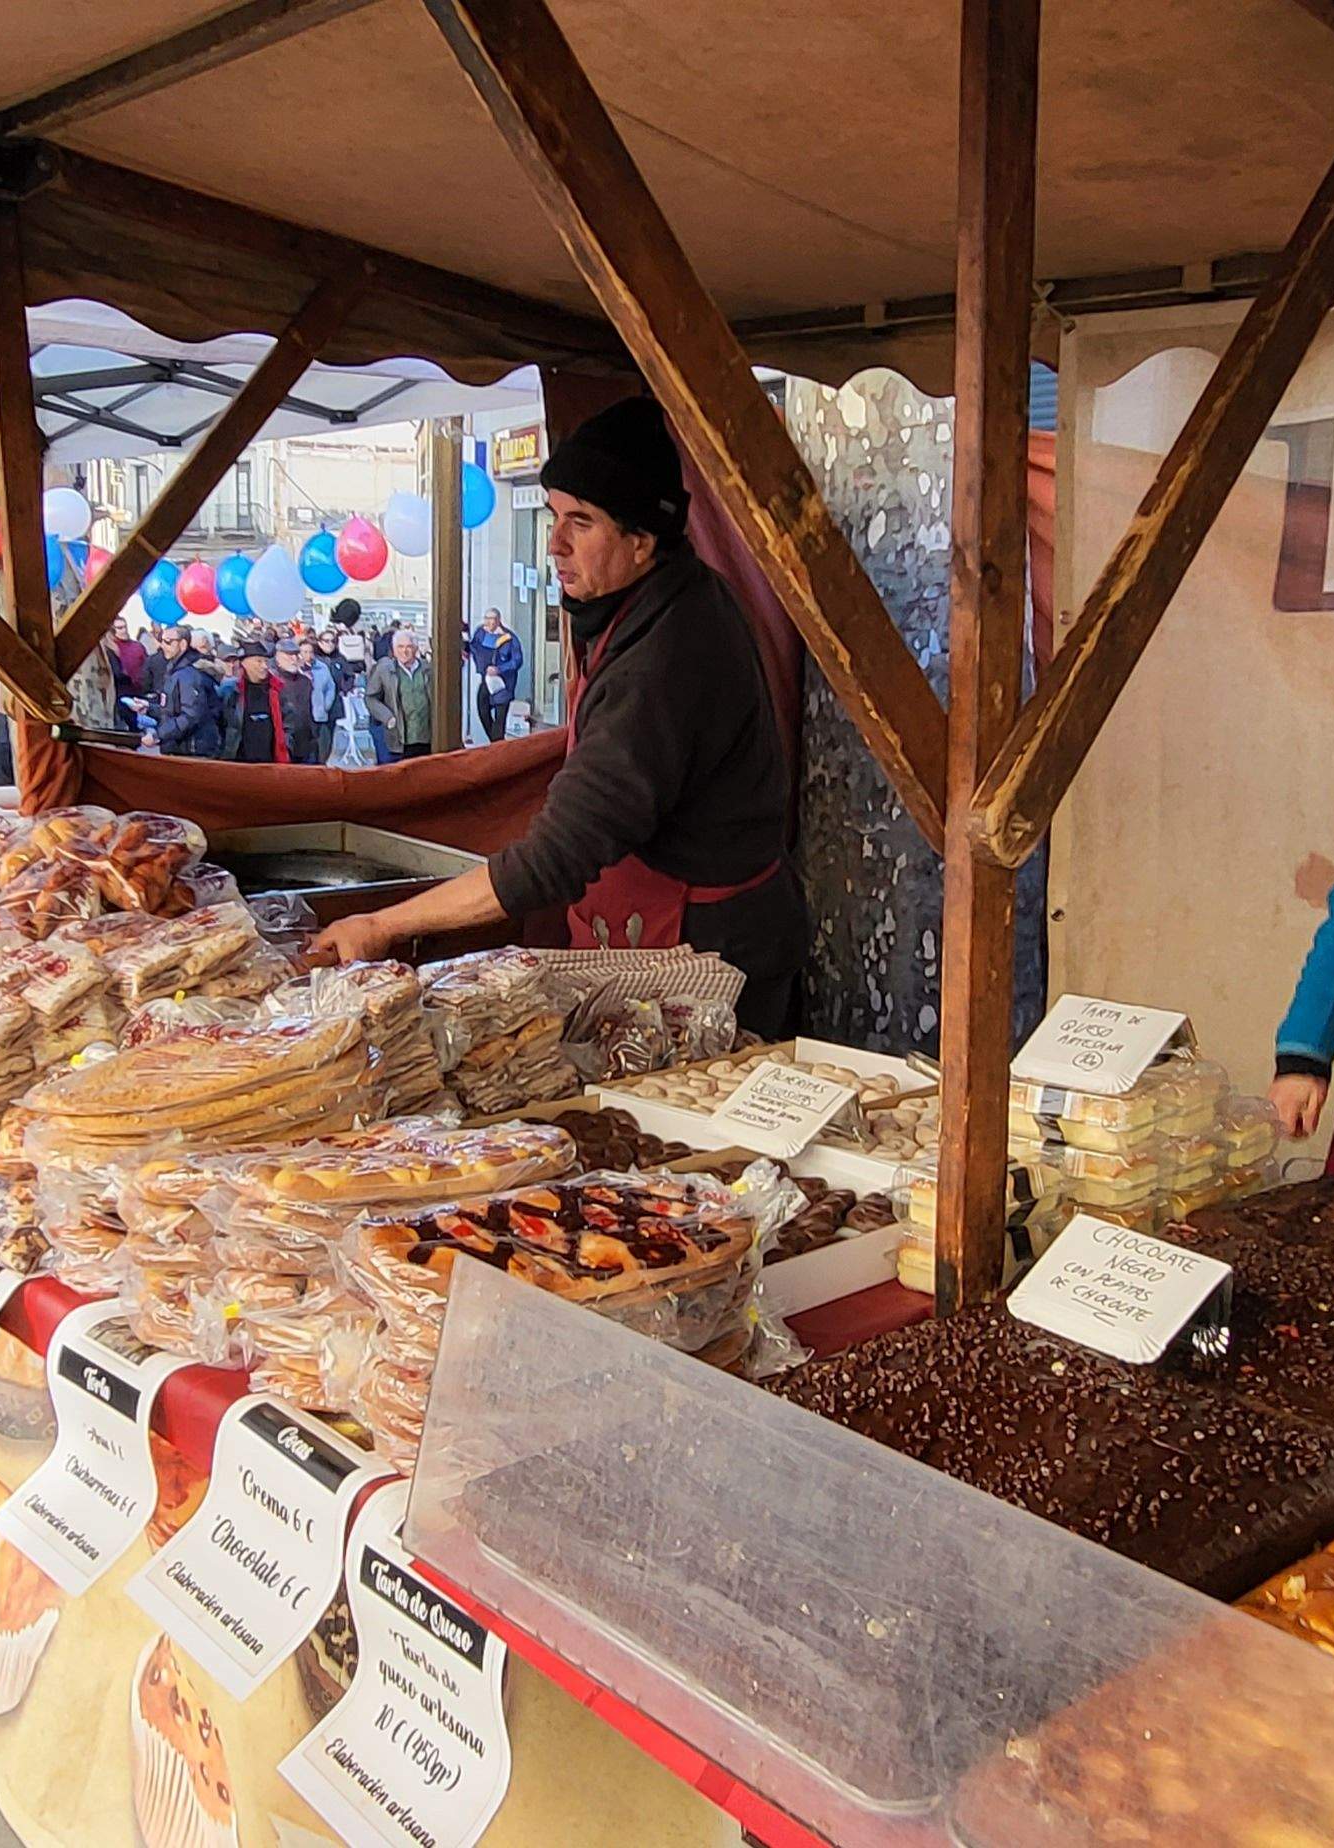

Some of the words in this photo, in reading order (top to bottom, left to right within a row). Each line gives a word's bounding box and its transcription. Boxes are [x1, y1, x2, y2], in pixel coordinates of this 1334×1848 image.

[1061, 1020, 1113, 1037] QUESO
[1080, 1001, 1122, 1023] TARTA
[1127, 1016, 1146, 1025] DE
[1058, 1035, 1124, 1053] ARTESANA
[1064, 1262, 1093, 1278] CON
[1092, 1226, 1201, 1273] CHOCOLATE
[1105, 1255, 1166, 1282] NEGRO
[1050, 1275, 1069, 1289] DE
[1072, 1284, 1154, 1322] CHOCOLATE
[277, 1426, 314, 1461] Cocas
[242, 1468, 289, 1525] Crema
[211, 1518, 280, 1588] Chocolate
[166, 1561, 223, 1618] Elaboración
[219, 1611, 265, 1656] artesana
[371, 1560, 411, 1610] Tarta
[410, 1591, 428, 1621] de
[429, 1604, 474, 1653] Queso
[394, 1632, 439, 1682] Tarta
[441, 1669, 461, 1697] de
[375, 1703, 394, 1731] 10
[379, 1660, 419, 1700] queso
[421, 1693, 486, 1758] artesana
[325, 1738, 387, 1806] Elaboración
[385, 1795, 437, 1848] artesana
